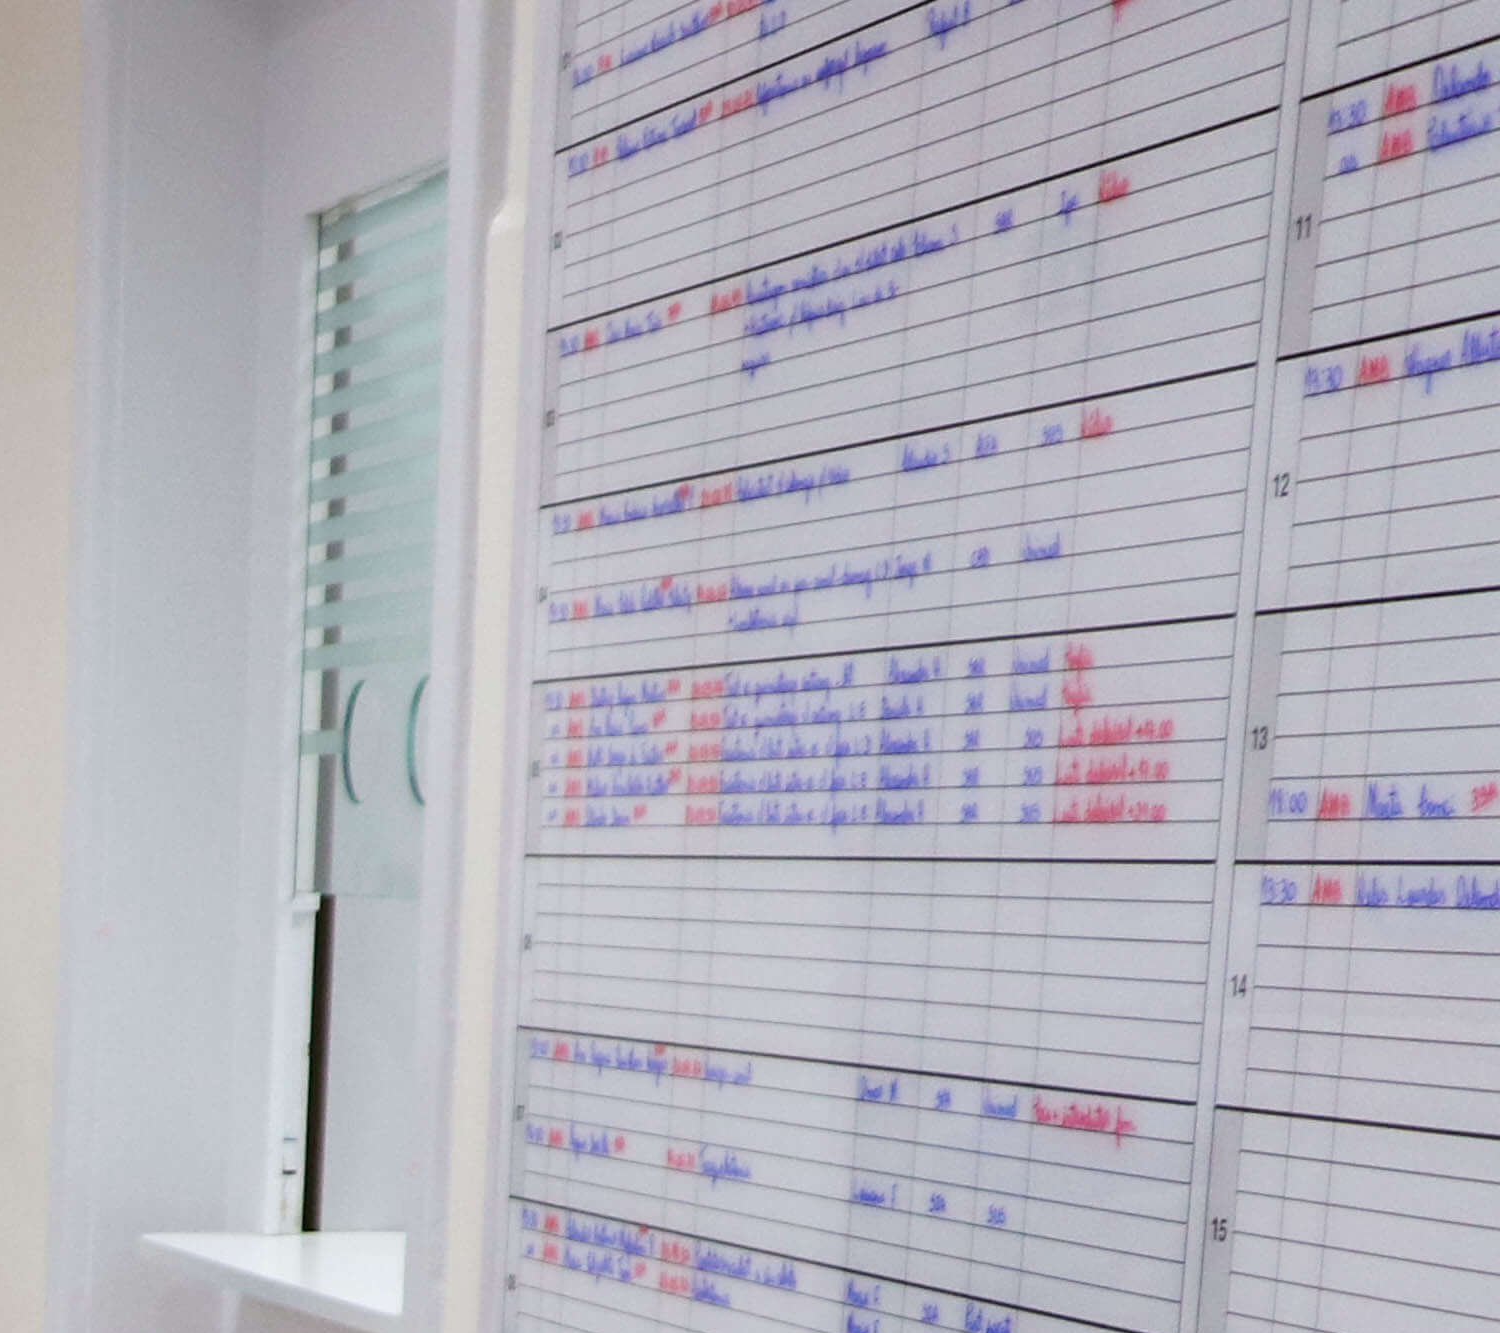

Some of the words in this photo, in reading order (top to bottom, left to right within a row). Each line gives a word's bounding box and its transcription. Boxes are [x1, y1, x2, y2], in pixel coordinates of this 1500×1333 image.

[1296, 214, 1312, 241] 11
[1273, 473, 1290, 497] 12
[1251, 726, 1269, 750] 13
[1231, 975, 1247, 998] 14
[1211, 1218, 1228, 1242] 15
